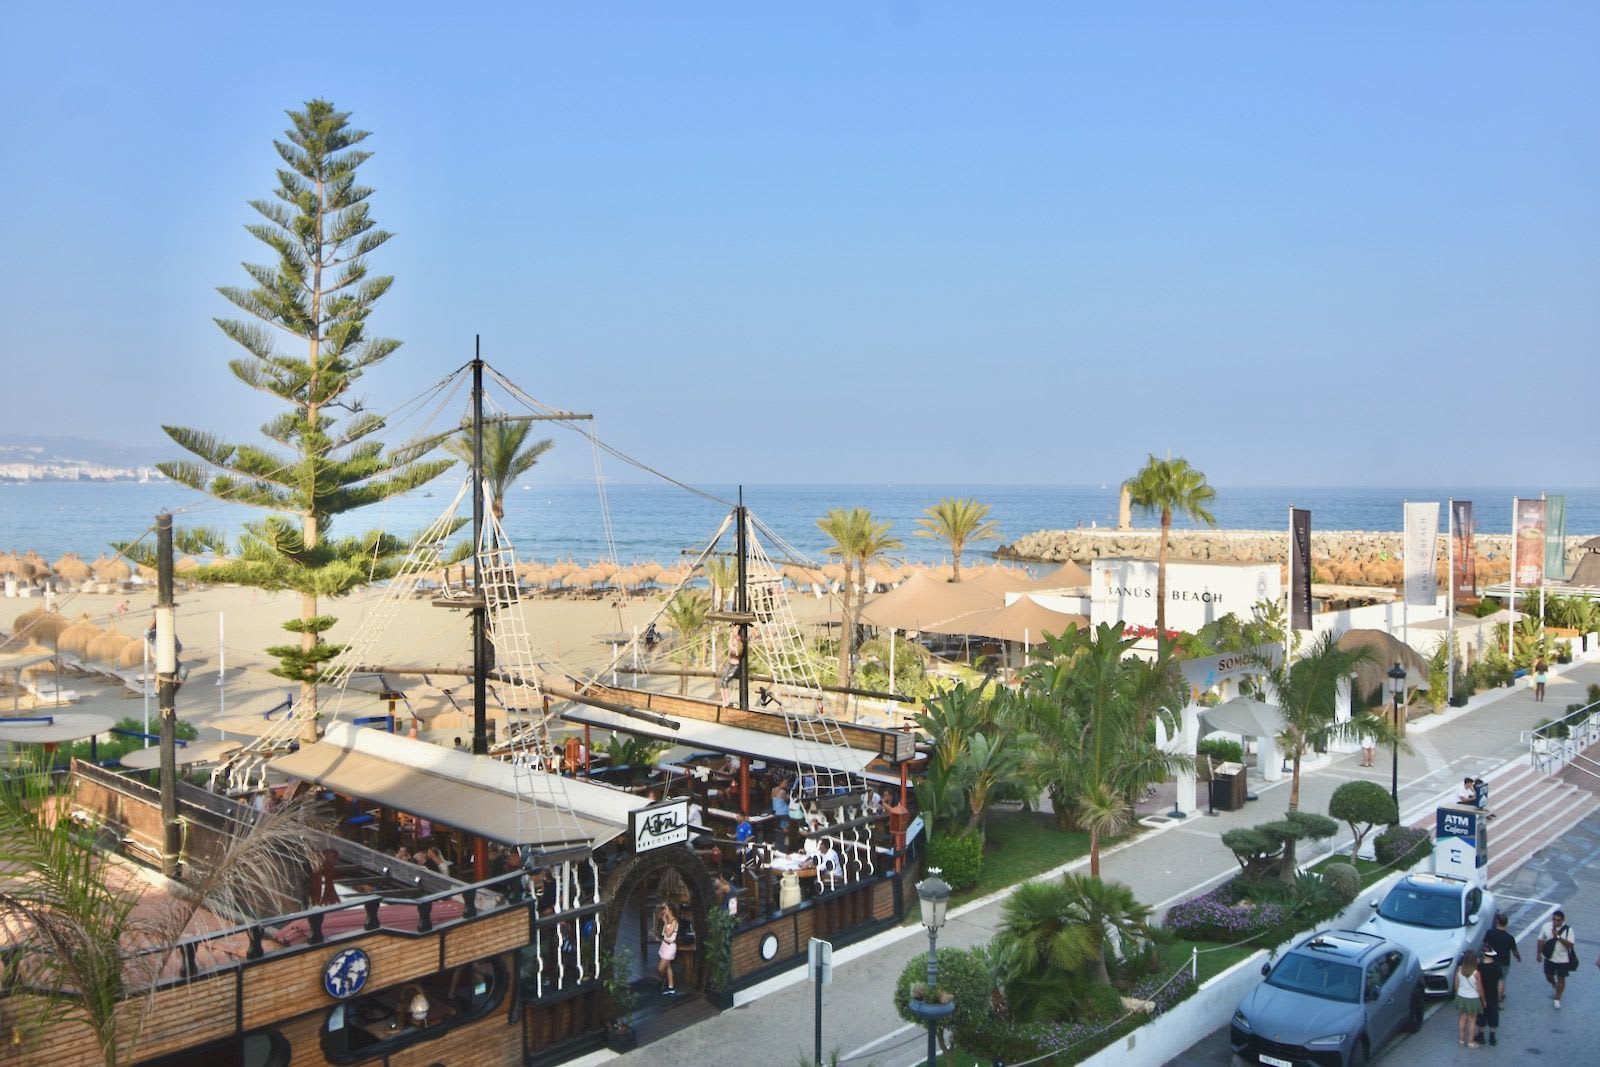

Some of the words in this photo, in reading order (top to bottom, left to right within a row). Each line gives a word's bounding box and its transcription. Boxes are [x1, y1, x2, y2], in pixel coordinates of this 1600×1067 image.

[1172, 590, 1223, 603] BEACH
[1445, 815, 1469, 826] ATM
[1444, 825, 1469, 835] Cajero
